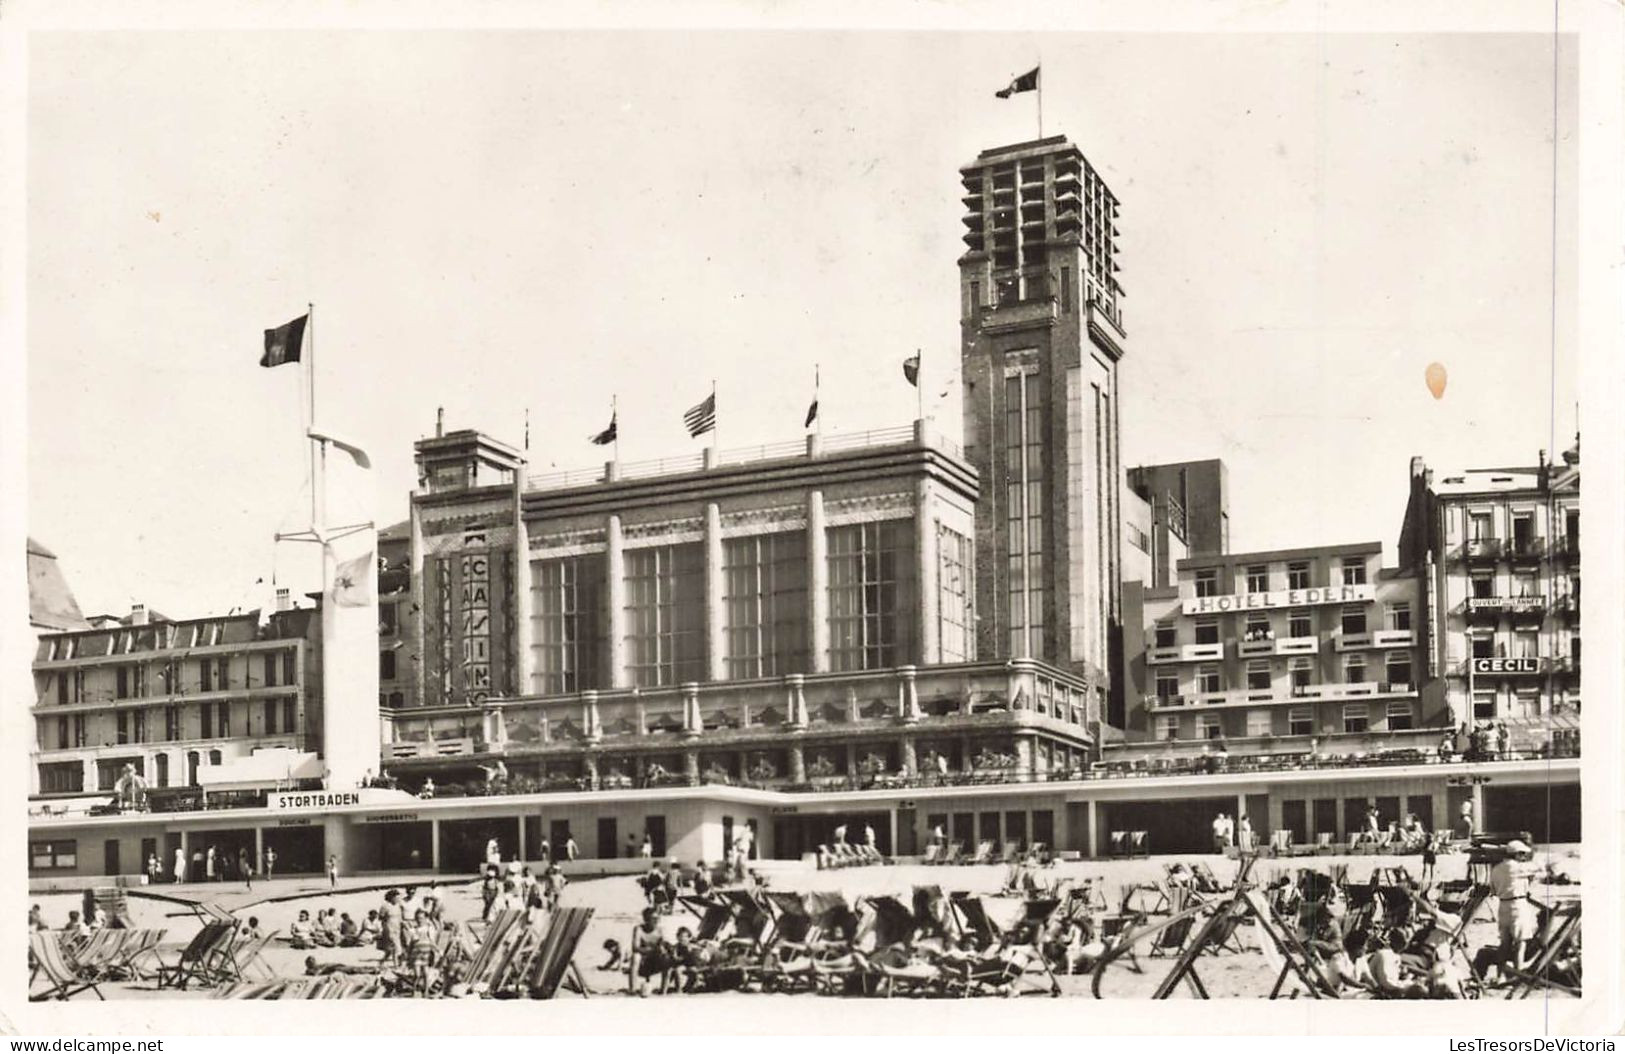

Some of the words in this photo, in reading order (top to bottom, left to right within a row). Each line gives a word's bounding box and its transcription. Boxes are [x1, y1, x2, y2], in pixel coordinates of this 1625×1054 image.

[1200, 593, 1276, 611] HOTEL
[1289, 587, 1355, 604] EDEN
[1479, 659, 1534, 671] CECIL
[279, 793, 359, 808] STORTBADEN
